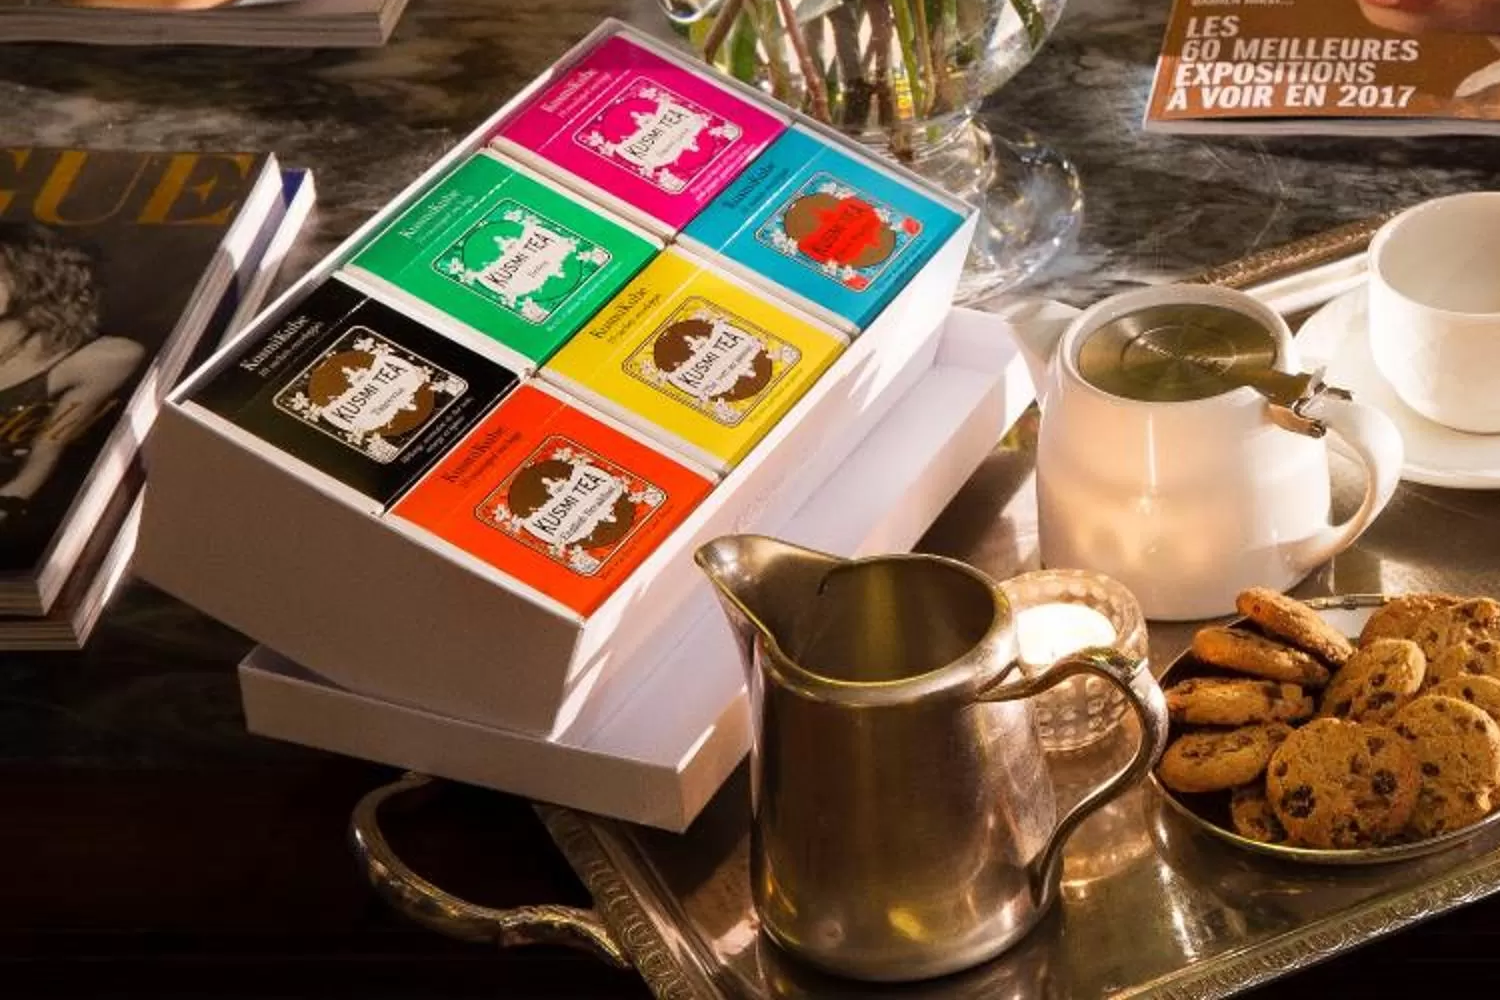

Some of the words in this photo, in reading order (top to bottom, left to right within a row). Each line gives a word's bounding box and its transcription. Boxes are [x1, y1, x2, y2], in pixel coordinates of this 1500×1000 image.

[1181, 39, 1221, 62] 60
[1232, 37, 1419, 61] MEILLEURES
[1186, 15, 1241, 38] LES
[1176, 61, 1377, 87] EXPOSITIONS
[1201, 85, 1273, 109] VOIR
[1284, 85, 1328, 108] EN
[1334, 85, 1417, 109] 2017
[624, 124, 666, 158] KUSMI
[661, 104, 688, 129] TEA
[485, 250, 530, 288] KUSMI
[522, 231, 552, 255] TEA
[678, 350, 721, 389] KUSMI
[717, 327, 748, 356] TEA
[331, 383, 377, 424] KUSMI
[373, 360, 407, 388] TEA
[532, 494, 580, 537] KUSMI
[571, 470, 608, 500] TEA
